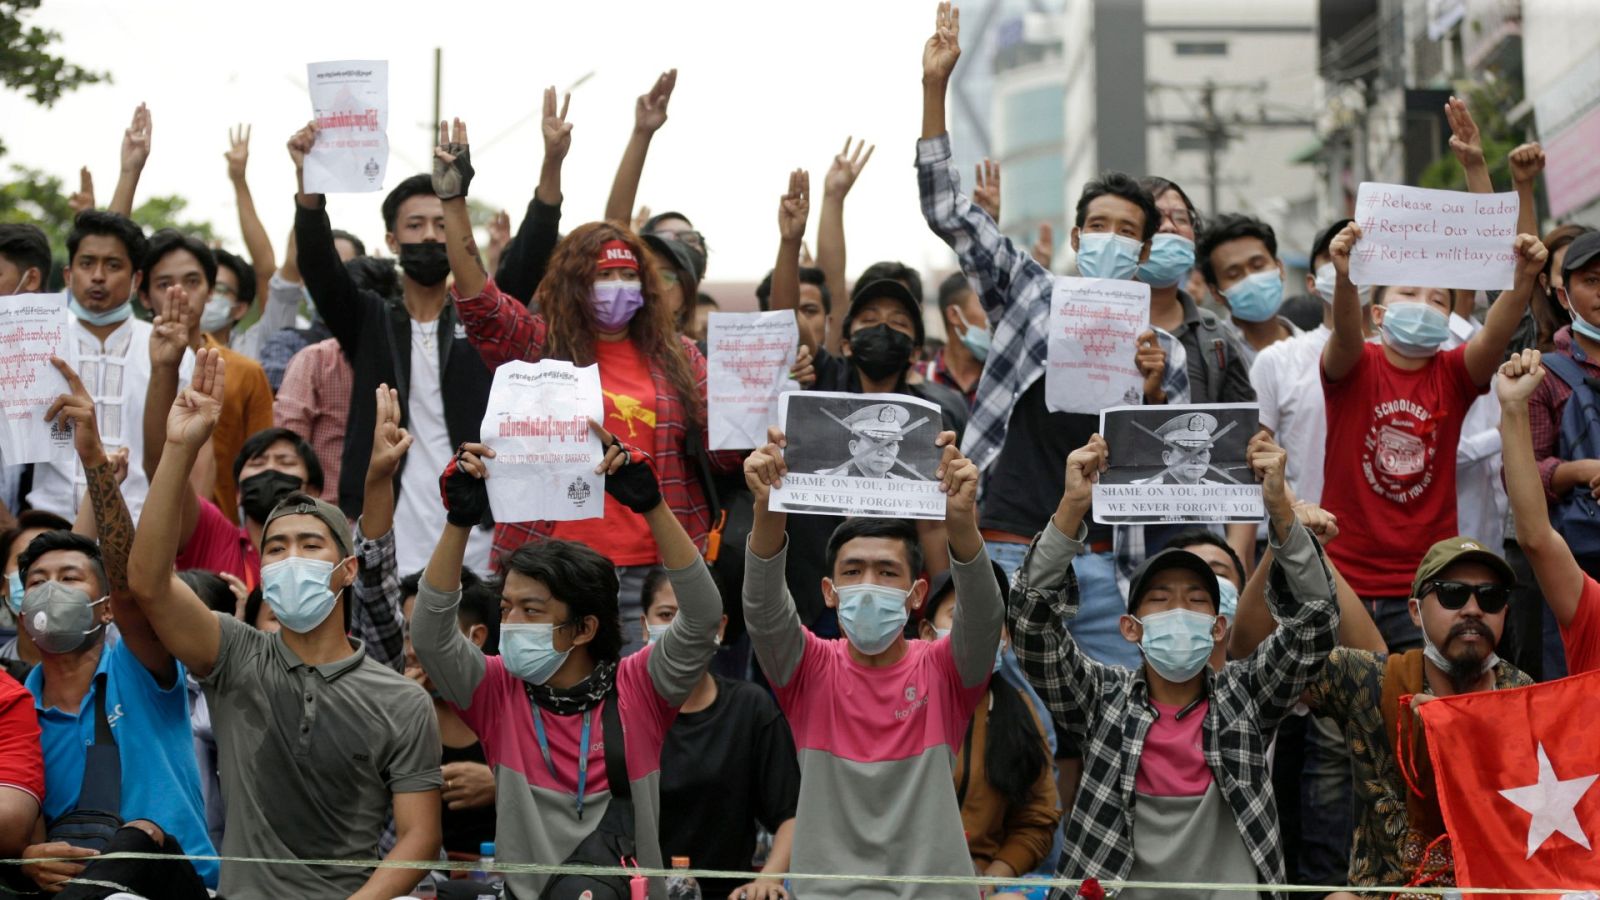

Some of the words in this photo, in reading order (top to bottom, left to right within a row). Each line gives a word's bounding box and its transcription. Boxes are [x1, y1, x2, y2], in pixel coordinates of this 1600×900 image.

[1365, 191, 1432, 212] #Release
[1441, 201, 1465, 214] our
[1361, 216, 1437, 240] #Respect
[1444, 226, 1468, 237] our
[1359, 243, 1428, 265] #Reject
[1435, 246, 1494, 266] military
[785, 475, 826, 488] SHAME
[832, 479, 849, 489] ON
[790, 492, 809, 501] WE
[814, 494, 853, 504] NEVER
[860, 497, 912, 508] FORGIVE
[919, 500, 944, 511] YOU
[1101, 487, 1142, 496] SHAME
[1147, 487, 1164, 496] ON
[1202, 487, 1261, 497] DICTATOR
[1107, 503, 1126, 512] WE
[1131, 503, 1170, 512] NEVER
[1176, 503, 1228, 512] FORGIVE
[1233, 503, 1257, 513] YOU
